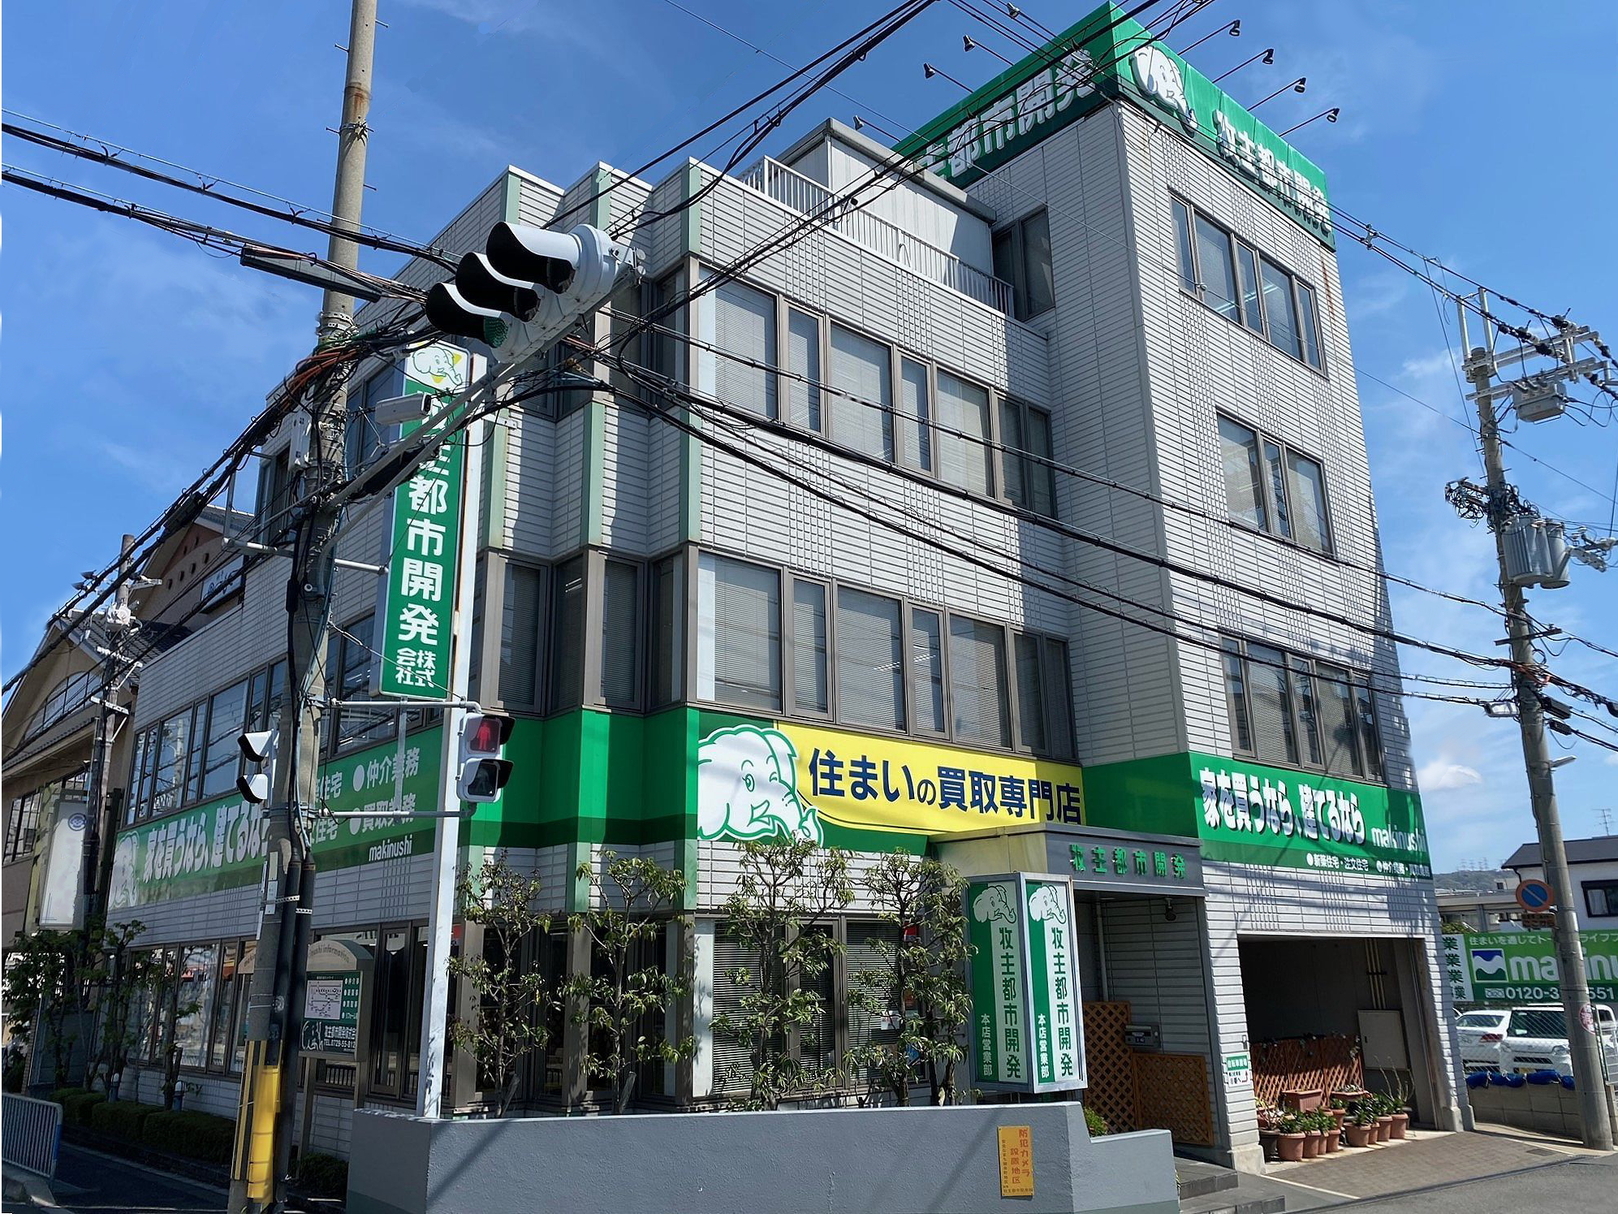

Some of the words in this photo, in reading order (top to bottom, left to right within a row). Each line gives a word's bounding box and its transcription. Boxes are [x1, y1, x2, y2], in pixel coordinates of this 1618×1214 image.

[316, 771, 343, 803] 住宅
[808, 748, 1082, 826] 住まいの買取専門店
[1199, 766, 1366, 845] 家を買うなら、建てるなら
[310, 816, 339, 845] 住宅
[369, 834, 413, 862] makinushi
[1371, 823, 1428, 852] makinushi
[999, 927, 1021, 1078] 牧主都市開発
[1051, 927, 1074, 1076] 牧主都市開発
[981, 1013, 993, 1077] 本店営業部
[1037, 1013, 1050, 1078] 本店営業部
[1019, 1129, 1030, 1177] 防犯カメラ
